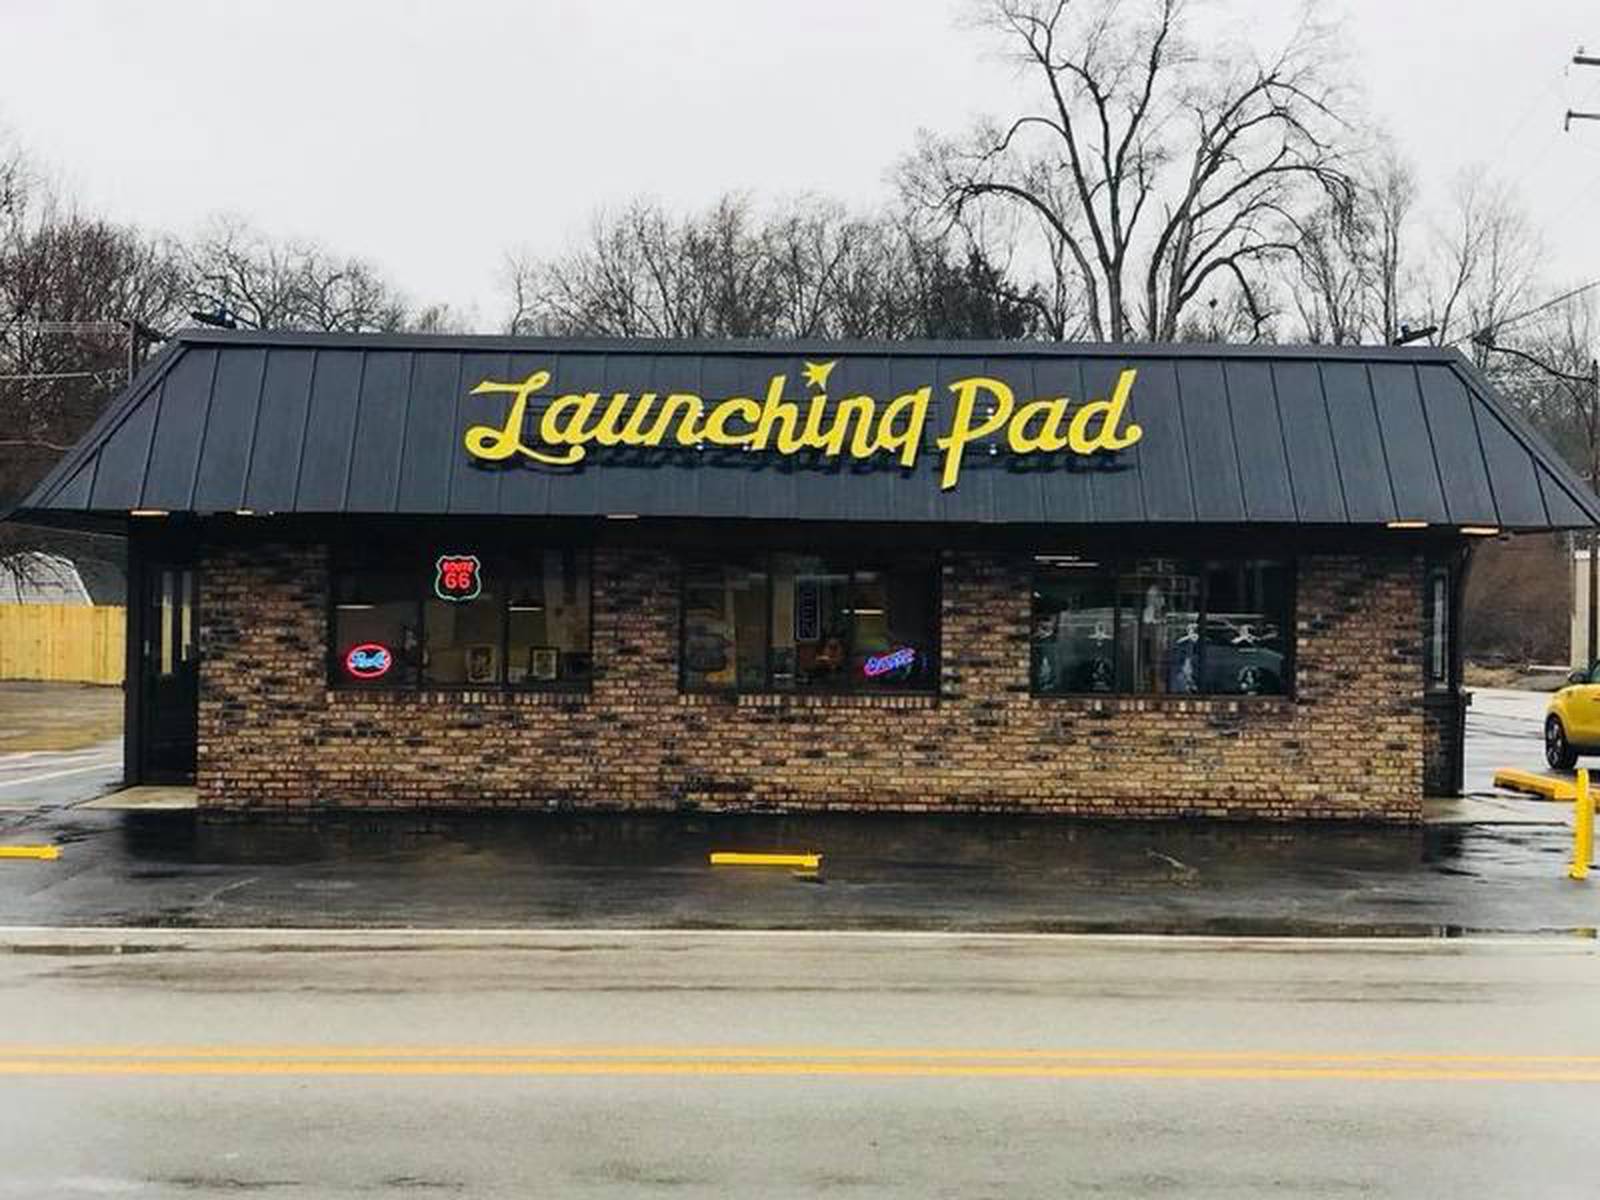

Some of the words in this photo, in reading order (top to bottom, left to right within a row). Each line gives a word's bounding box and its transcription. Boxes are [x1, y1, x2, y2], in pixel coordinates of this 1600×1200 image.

[464, 362, 931, 466] Launching
[936, 369, 1142, 489] Pad
[445, 573, 471, 589] 66
